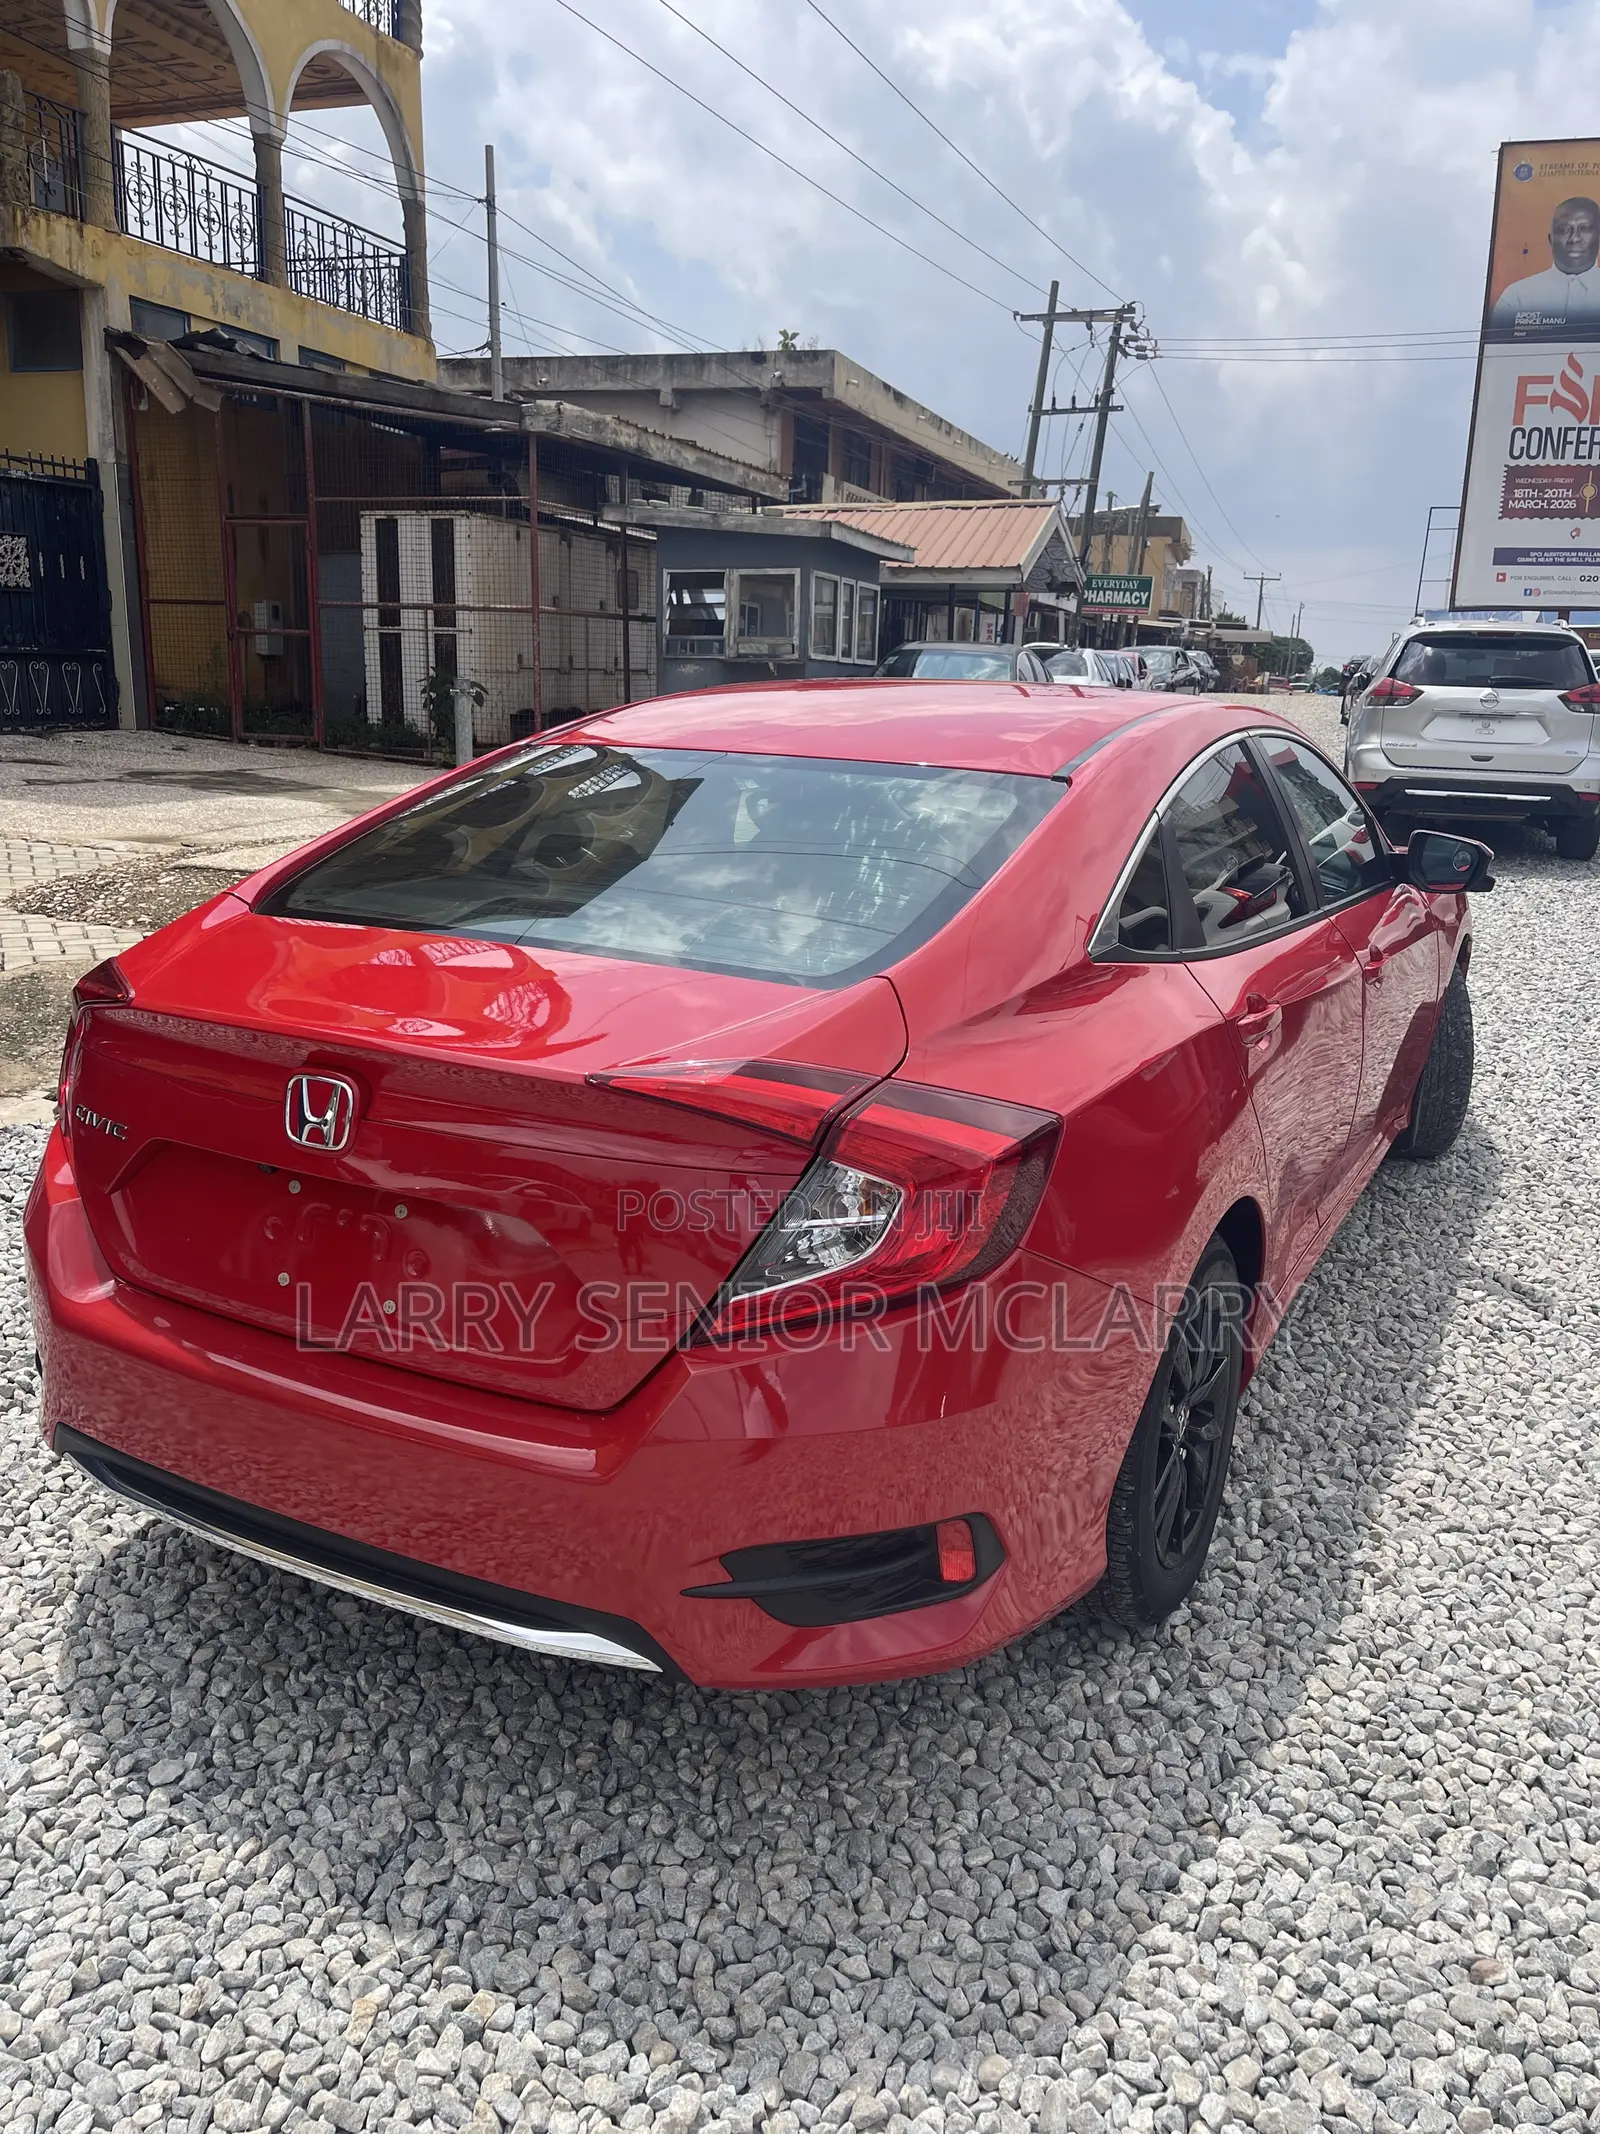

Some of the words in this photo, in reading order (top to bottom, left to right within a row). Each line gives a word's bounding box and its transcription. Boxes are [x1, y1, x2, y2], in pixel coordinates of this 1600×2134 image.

[1578, 161, 1588, 169] OF
[1513, 489, 1538, 498] 18TH
[1543, 489, 1572, 498] 20TH
[1550, 500, 1577, 509] 2026
[1091, 579, 1140, 589] EVERYDAY
[75, 1104, 128, 1140] CIVIC
